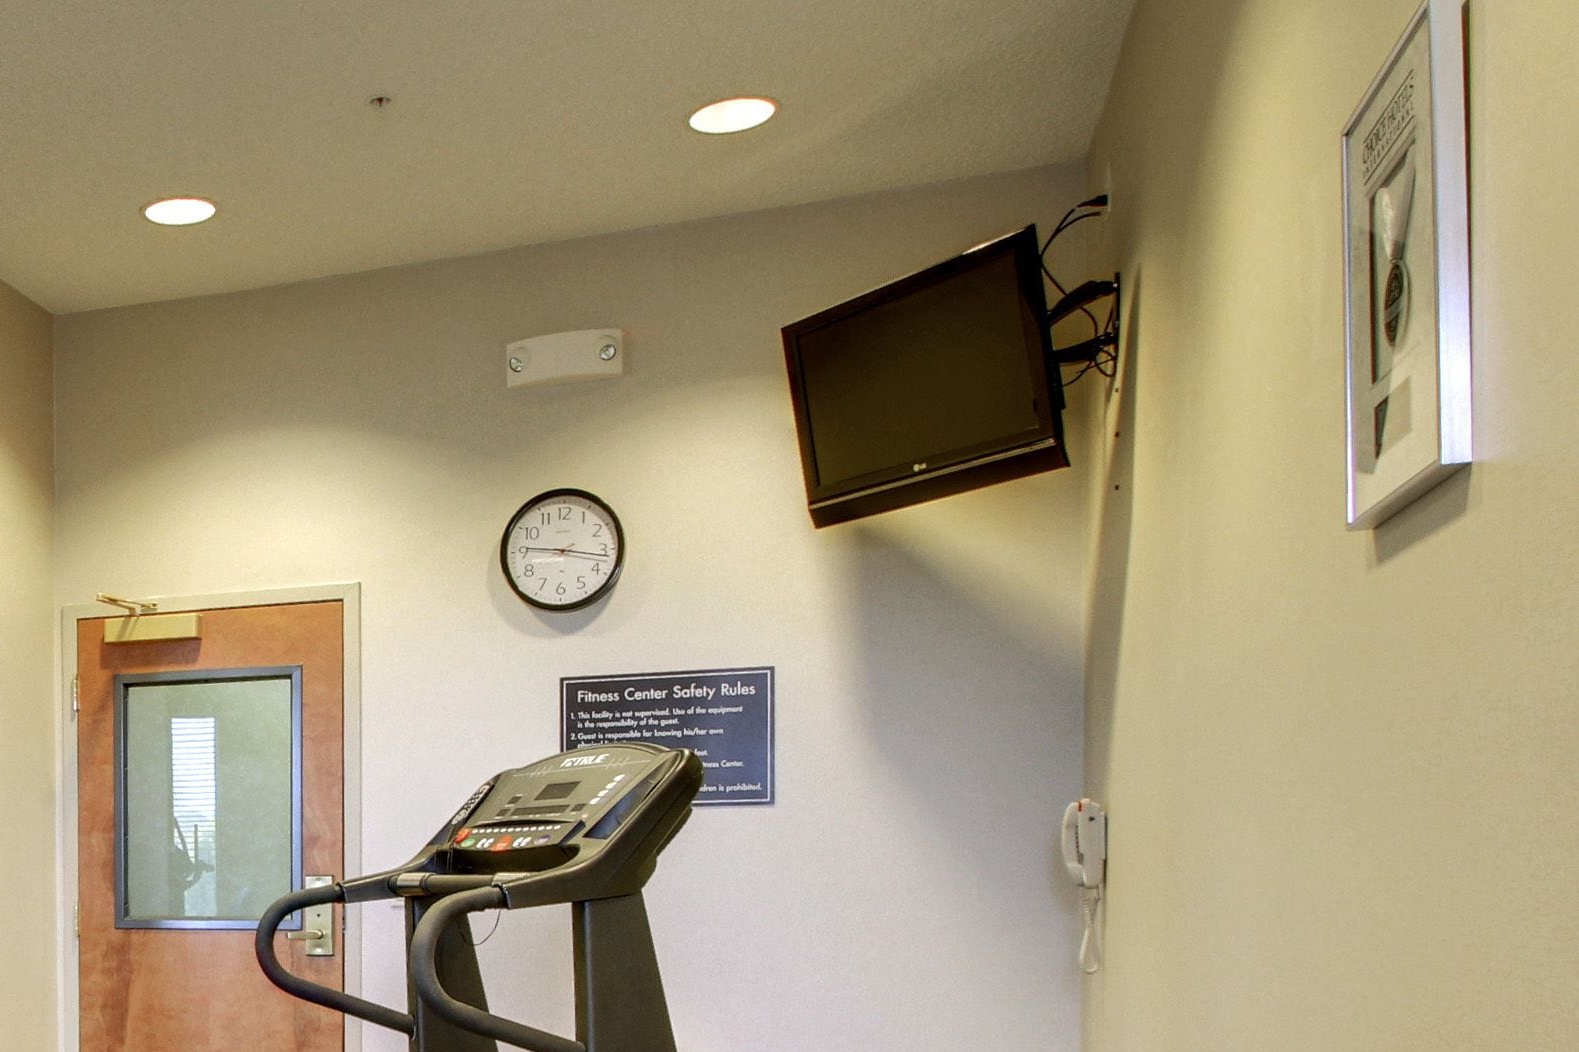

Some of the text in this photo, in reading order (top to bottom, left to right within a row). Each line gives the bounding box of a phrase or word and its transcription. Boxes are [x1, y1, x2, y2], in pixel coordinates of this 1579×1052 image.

[541, 512, 551, 526] 11
[558, 507, 572, 521] 12
[525, 526, 540, 540] 10
[592, 524, 602, 538] 2
[518, 546, 528, 559] 9
[599, 543, 607, 556] 3
[523, 564, 534, 578] 8
[591, 562, 601, 575] 4
[539, 577, 547, 591] 7
[556, 582, 566, 595] 6
[576, 576, 586, 589] 5
[577, 680, 756, 703] Fitness Center Safety Rules
[578, 711, 590, 719] This
[592, 710, 613, 719] facility
[615, 710, 621, 718] is
[634, 707, 671, 718] supervised.
[686, 706, 695, 715] of
[695, 706, 707, 714] the
[708, 706, 743, 715] equipment
[584, 720, 595, 728] the
[596, 718, 638, 729] responsibility
[639, 718, 647, 726] of
[648, 717, 659, 725] the
[660, 718, 679, 727] guest.
[577, 732, 597, 740] Guest
[605, 729, 641, 740] responsible
[642, 729, 653, 737] for
[654, 728, 682, 738] knowing
[683, 727, 708, 736] his/her
[721, 759, 745, 768] Center.
[718, 784, 724, 792] is
[726, 782, 762, 793] prohibited.
